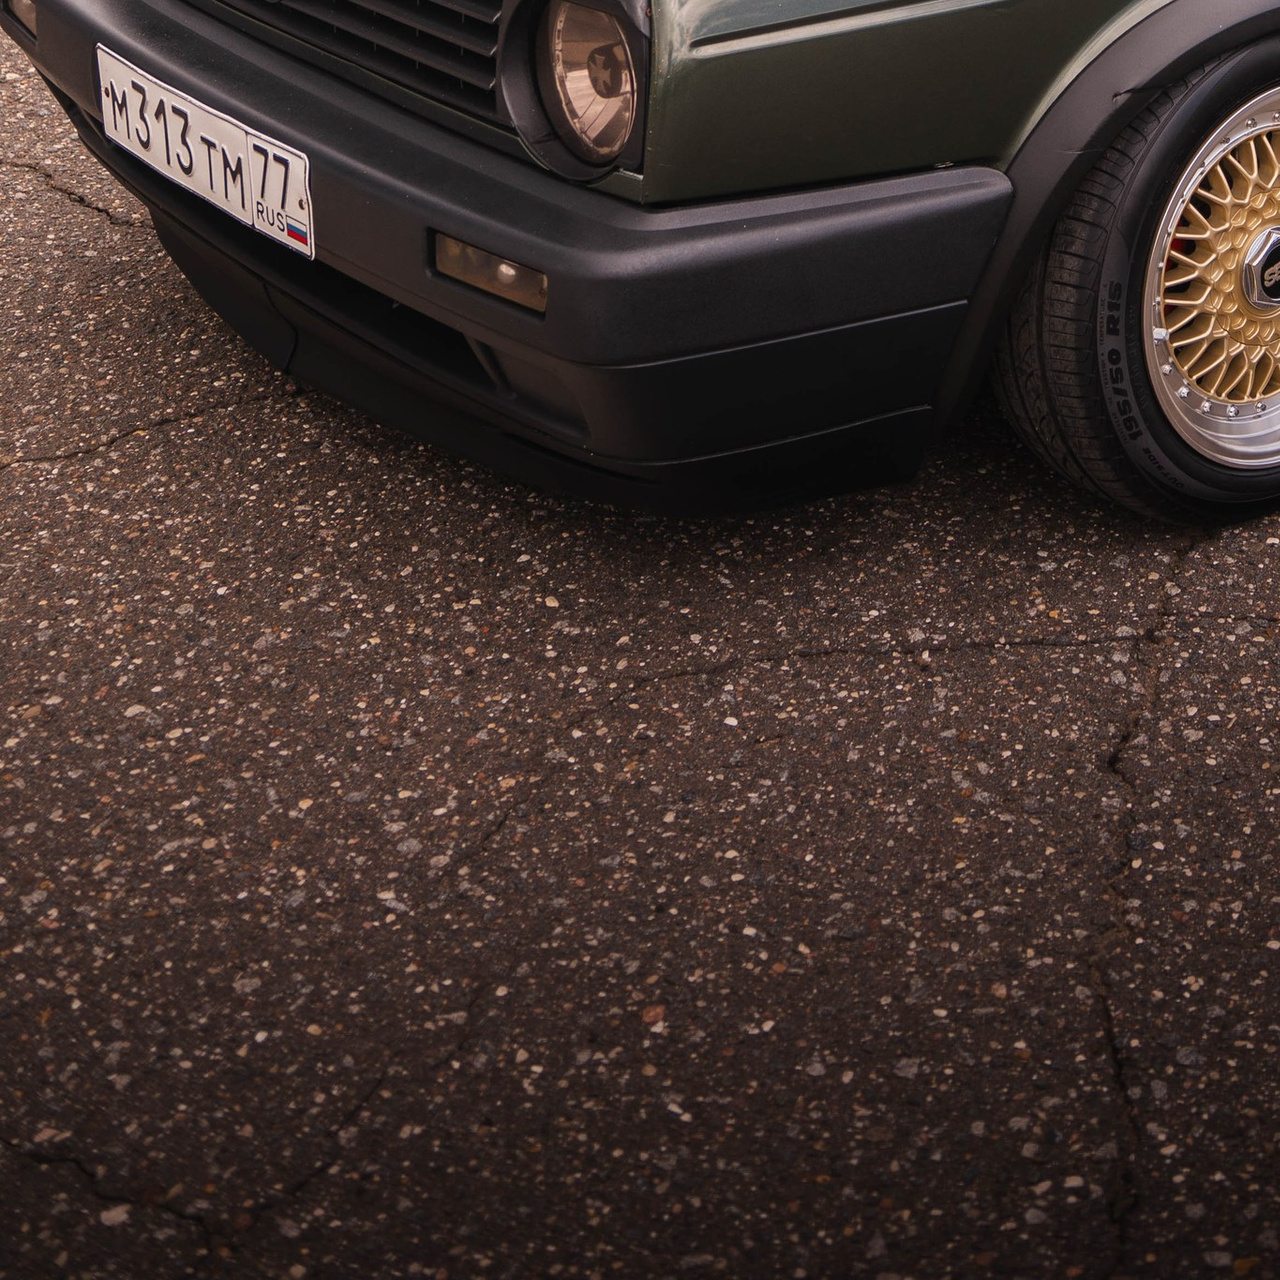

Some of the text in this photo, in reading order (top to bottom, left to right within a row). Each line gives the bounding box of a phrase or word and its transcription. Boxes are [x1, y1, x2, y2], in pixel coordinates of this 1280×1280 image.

[252, 142, 290, 210] 77
[255, 200, 286, 233] RUS
[1105, 280, 1122, 337] R15
[1107, 347, 1143, 441] 195/50
